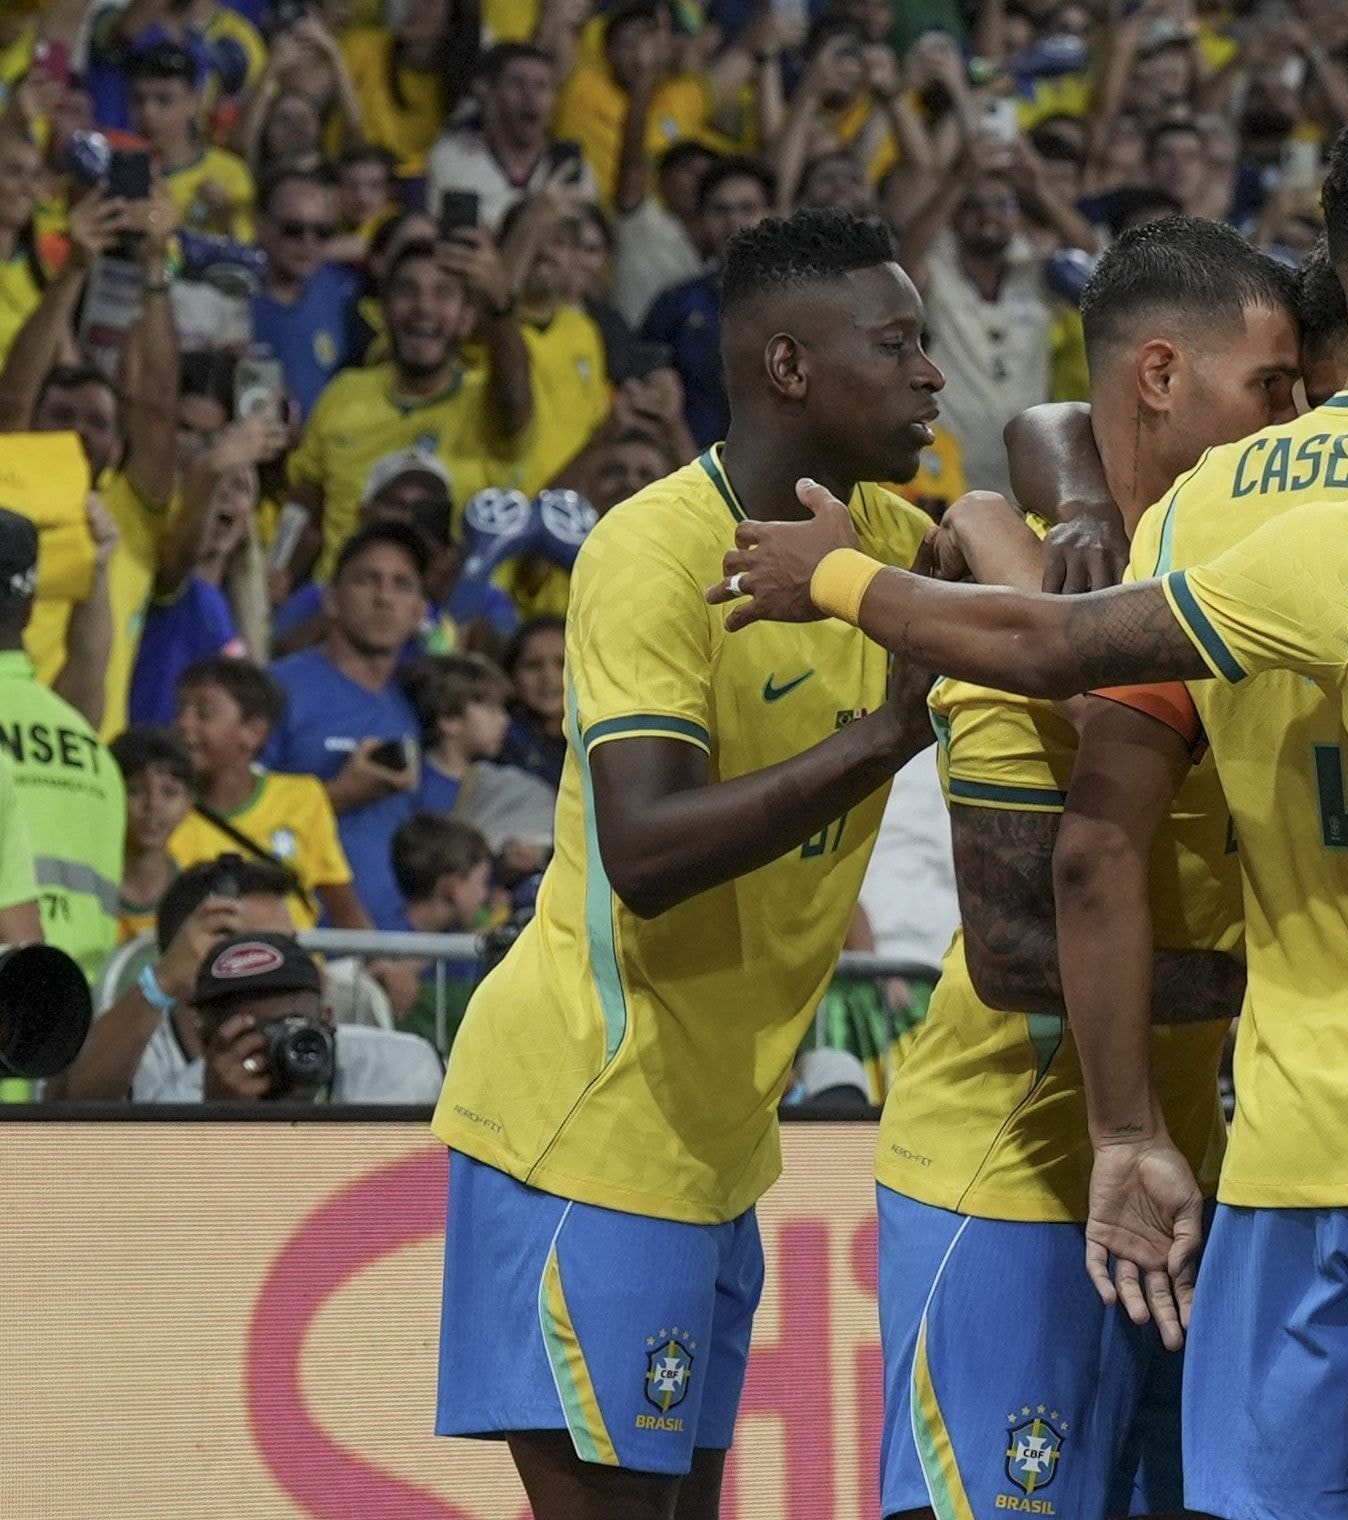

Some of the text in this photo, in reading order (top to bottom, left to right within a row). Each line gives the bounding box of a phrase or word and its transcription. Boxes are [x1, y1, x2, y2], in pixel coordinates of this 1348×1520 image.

[660, 1369, 679, 1379] CBF
[635, 1414, 685, 1432] BRASIL
[1023, 1448, 1045, 1460] CBF
[995, 1494, 1056, 1515] BRASIL
